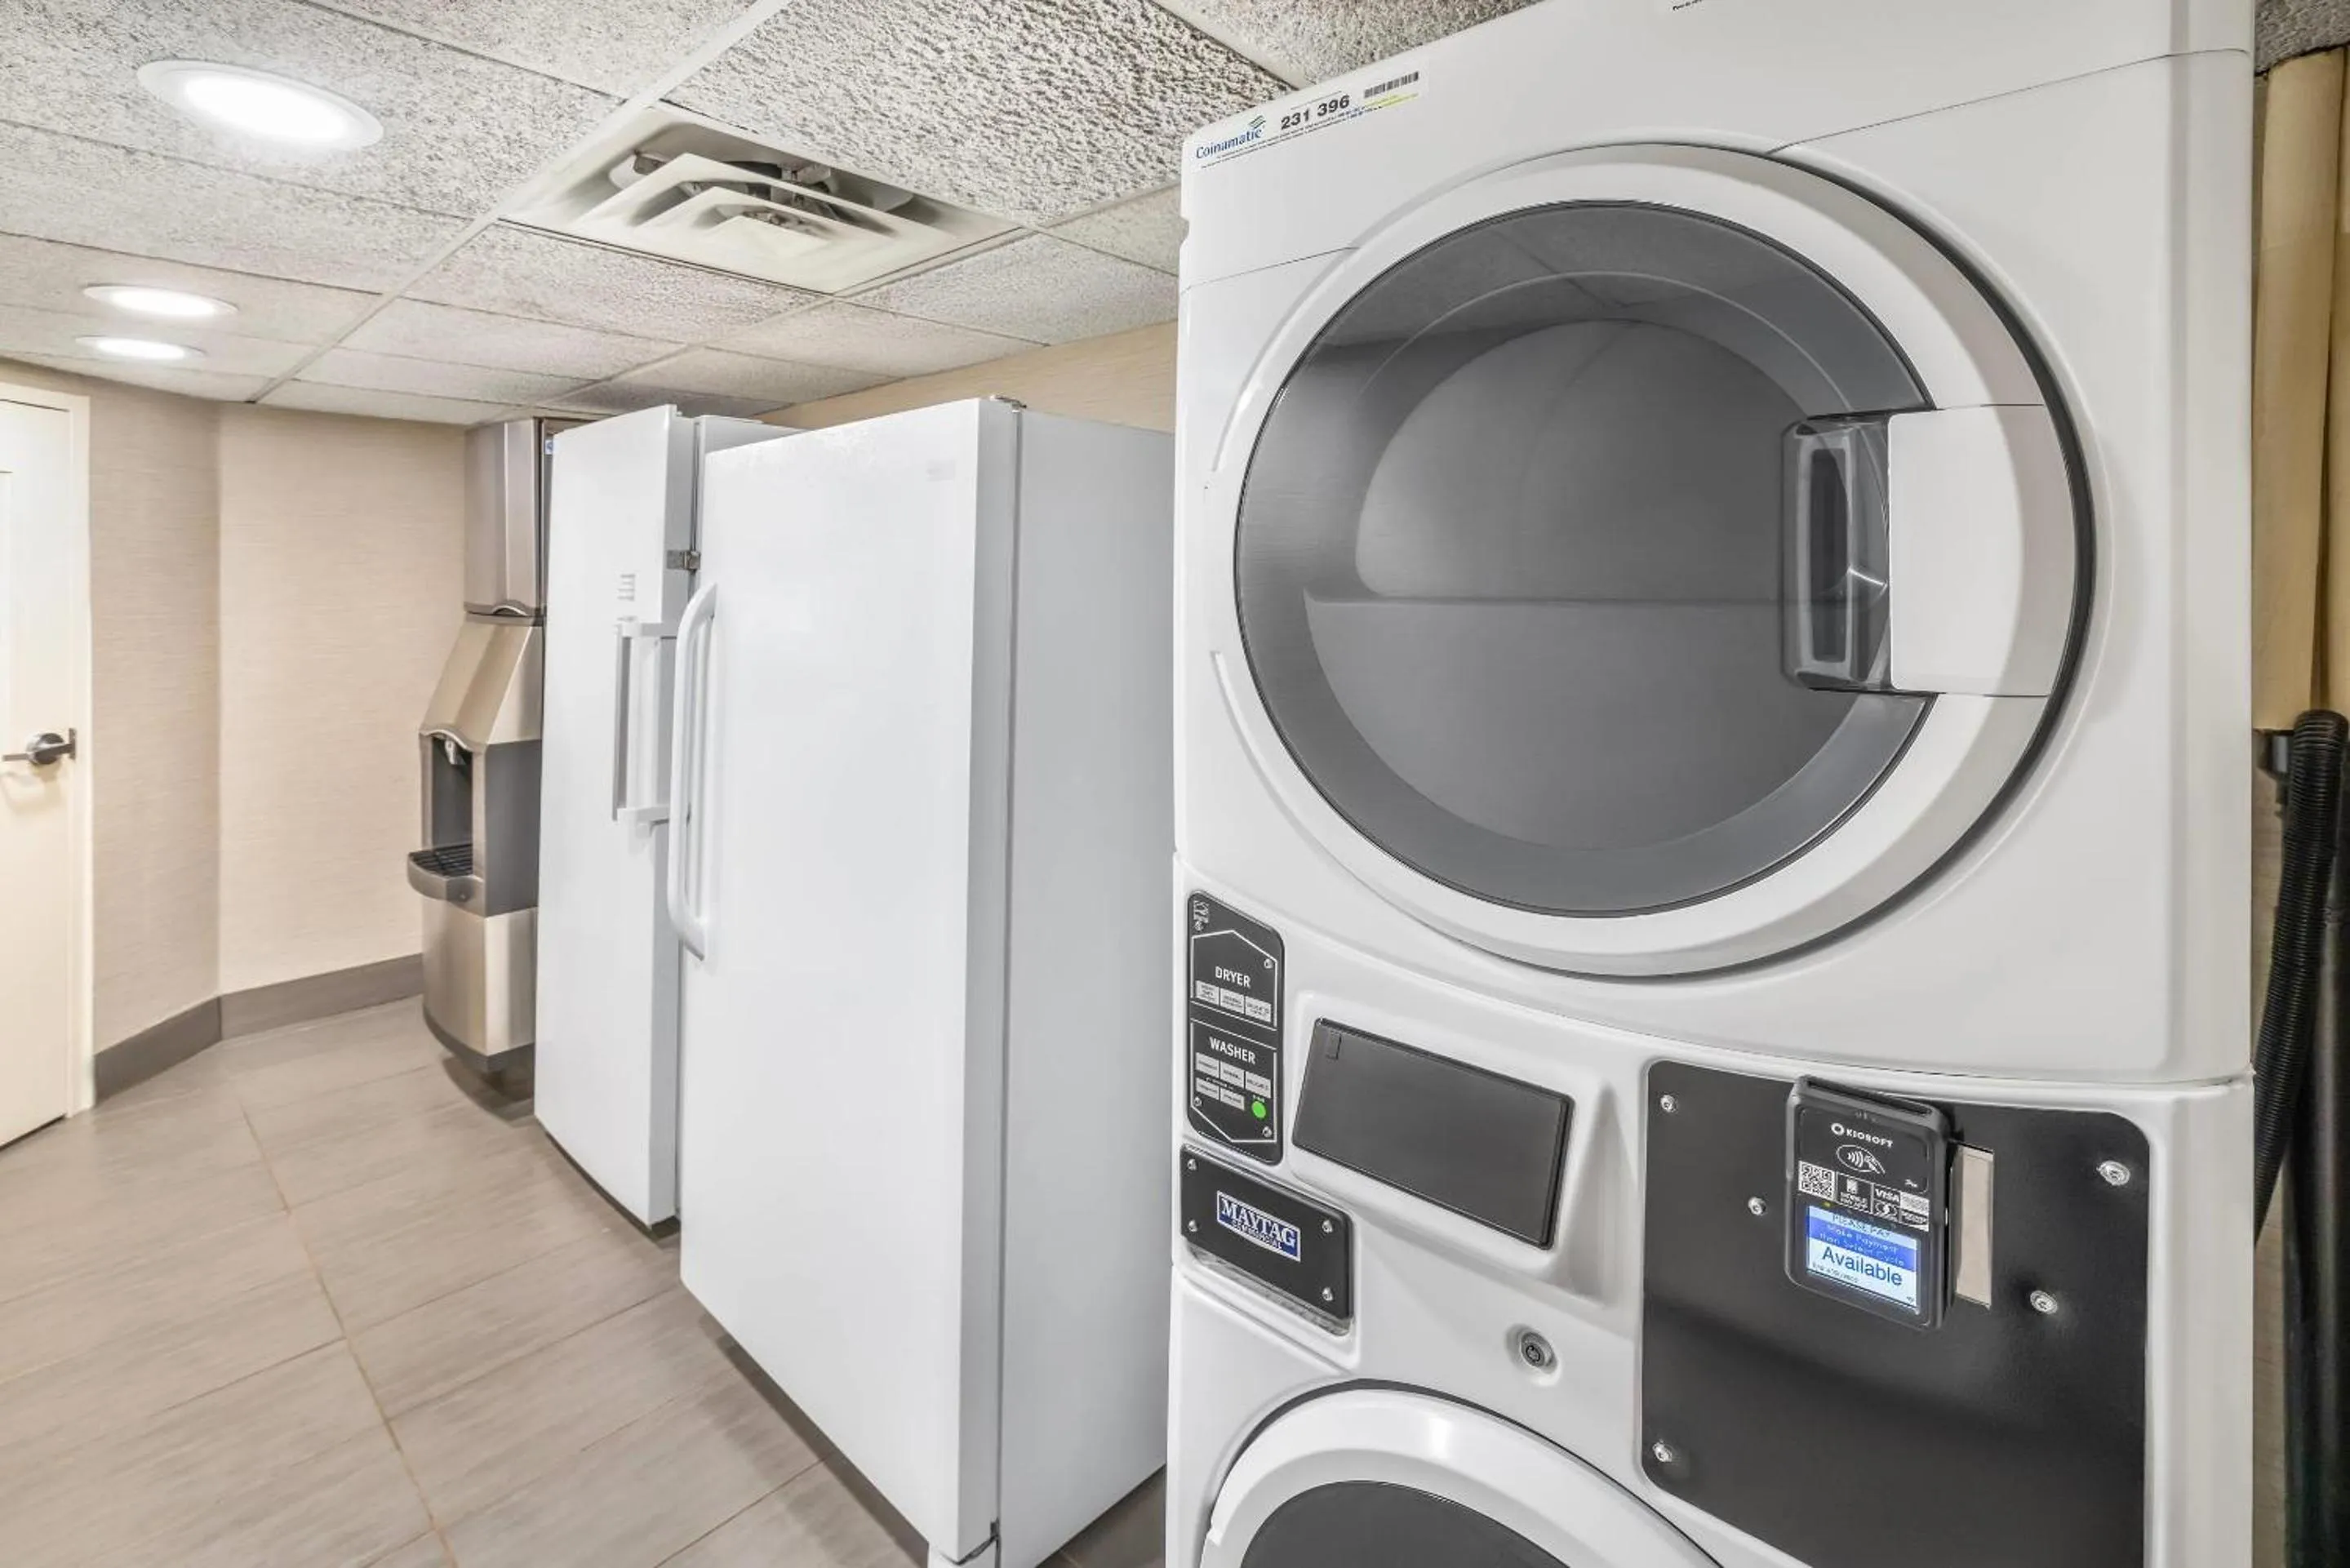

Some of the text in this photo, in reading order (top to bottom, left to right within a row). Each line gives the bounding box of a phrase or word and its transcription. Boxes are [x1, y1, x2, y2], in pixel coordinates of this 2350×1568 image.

[1281, 110, 1310, 130] 231
[1317, 94, 1350, 118] 396
[1196, 126, 1262, 159] Coinamatic
[1215, 966, 1251, 988] DRYER
[1209, 1036, 1255, 1064] WASHER
[1875, 1188, 1899, 1202] VISA
[1221, 1197, 1296, 1248] MAYTAG
[1822, 1246, 1903, 1286] Available
